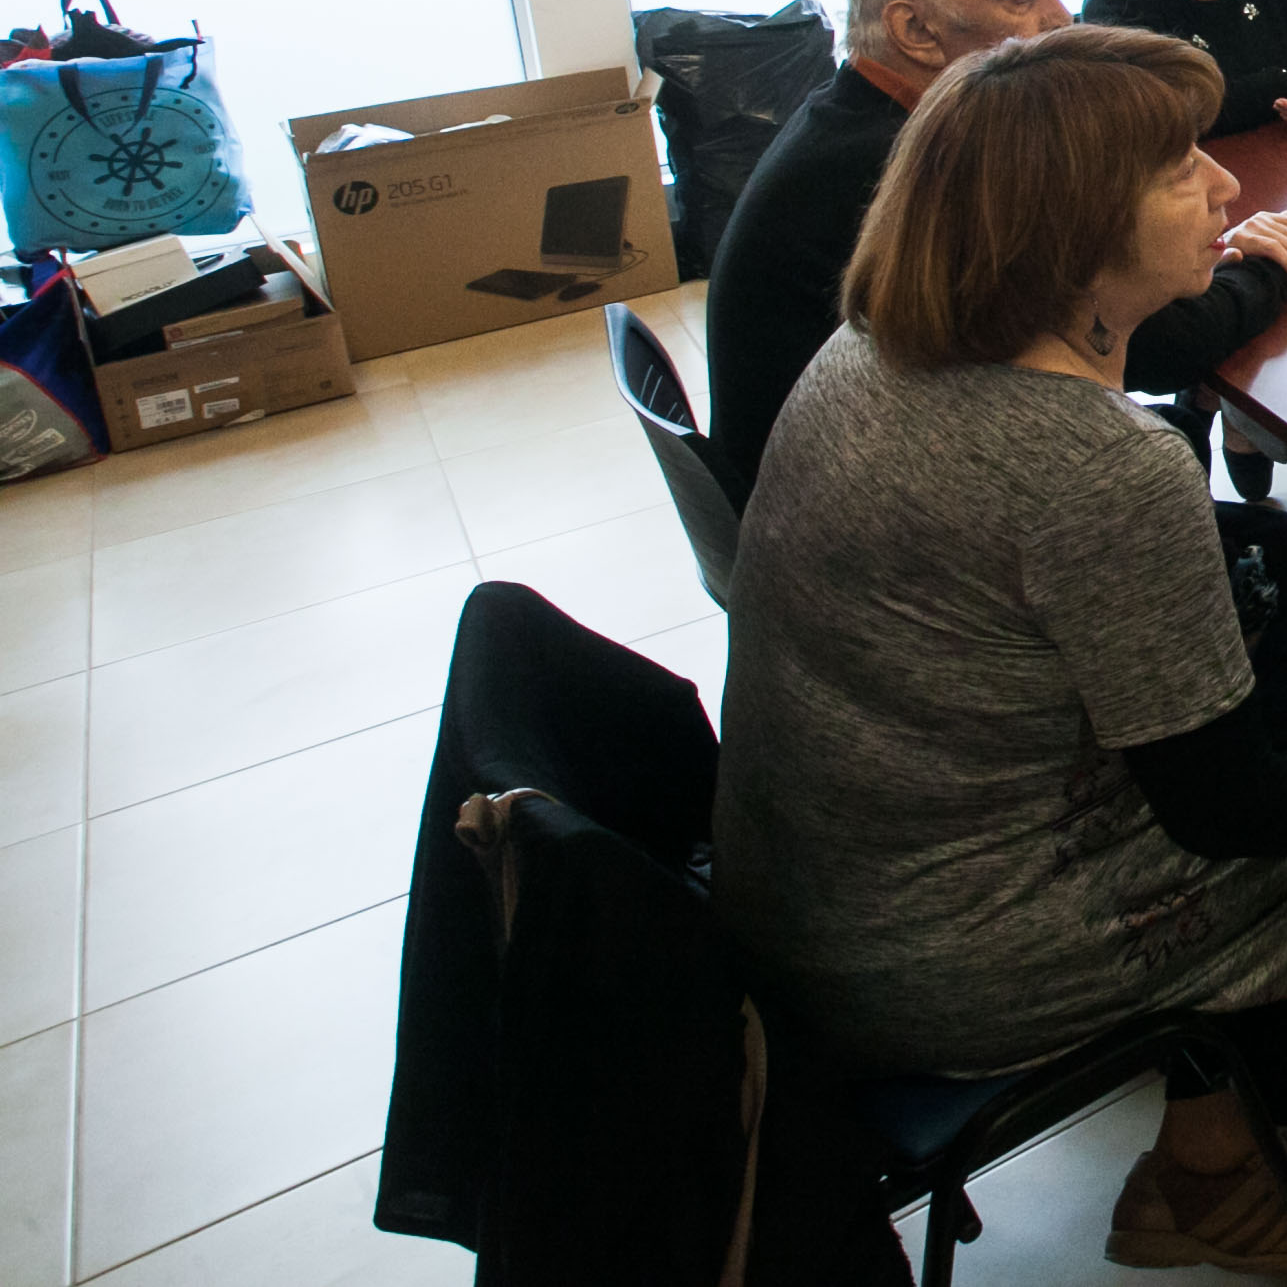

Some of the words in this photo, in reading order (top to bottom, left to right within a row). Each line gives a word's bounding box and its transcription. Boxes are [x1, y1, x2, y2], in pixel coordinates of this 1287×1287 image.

[337, 181, 375, 214] hp
[387, 179, 425, 199] 205
[430, 174, 452, 192] G1
